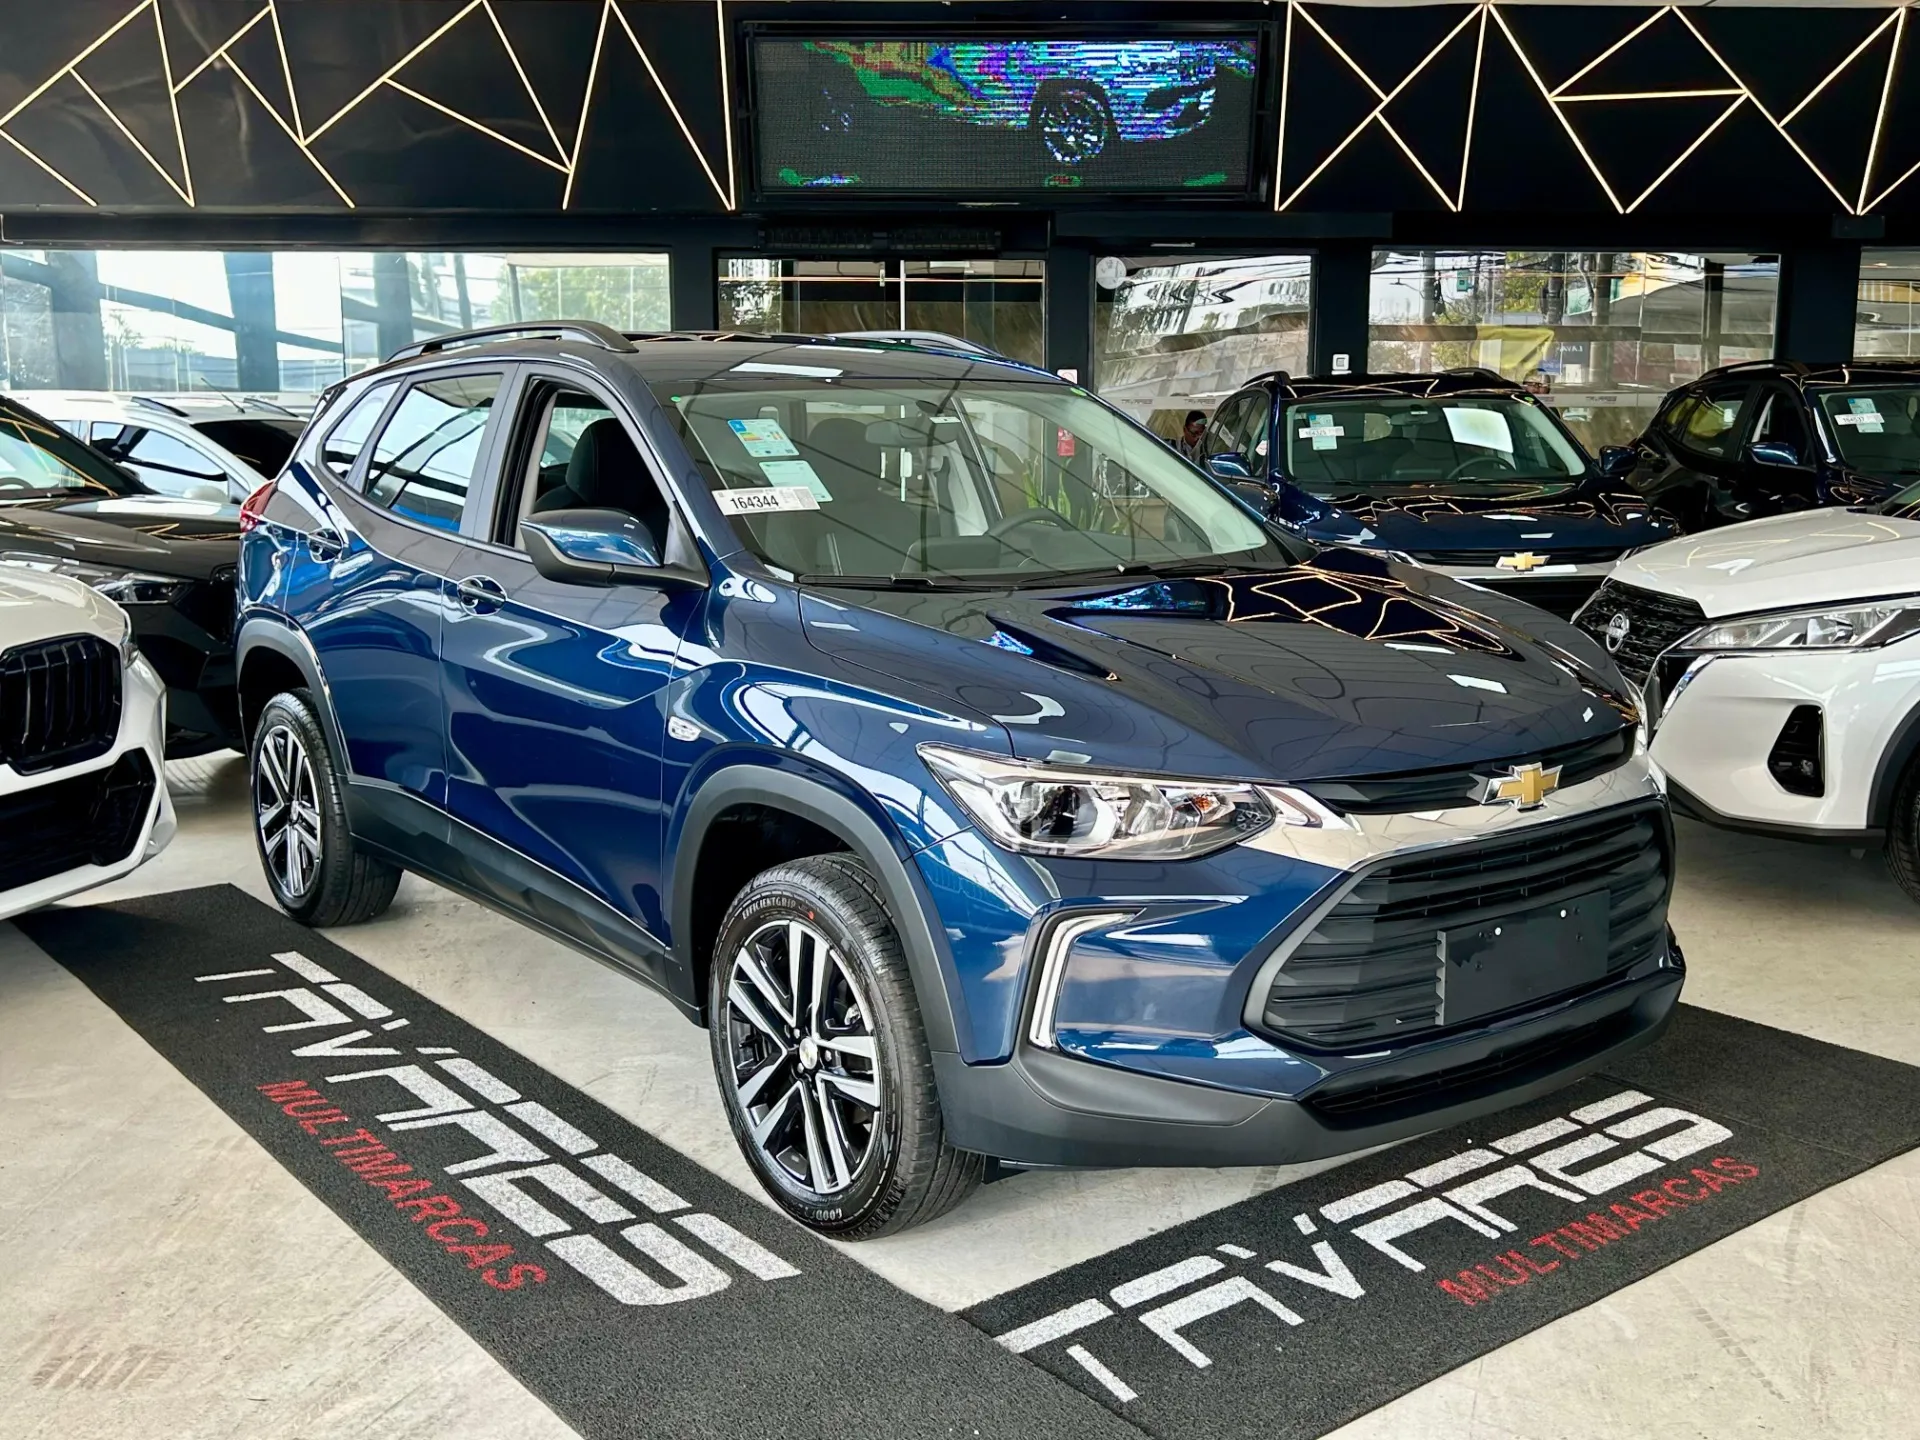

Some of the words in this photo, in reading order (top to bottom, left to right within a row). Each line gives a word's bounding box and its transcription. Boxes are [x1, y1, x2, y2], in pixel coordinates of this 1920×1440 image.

[730, 495, 779, 510] 164344
[195, 951, 803, 1306] TAVARES
[256, 1080, 547, 1291] MULTIMARCAS
[1437, 1156, 1761, 1308] MULTIMARCAS
[993, 1089, 1734, 1404] TAVARES
